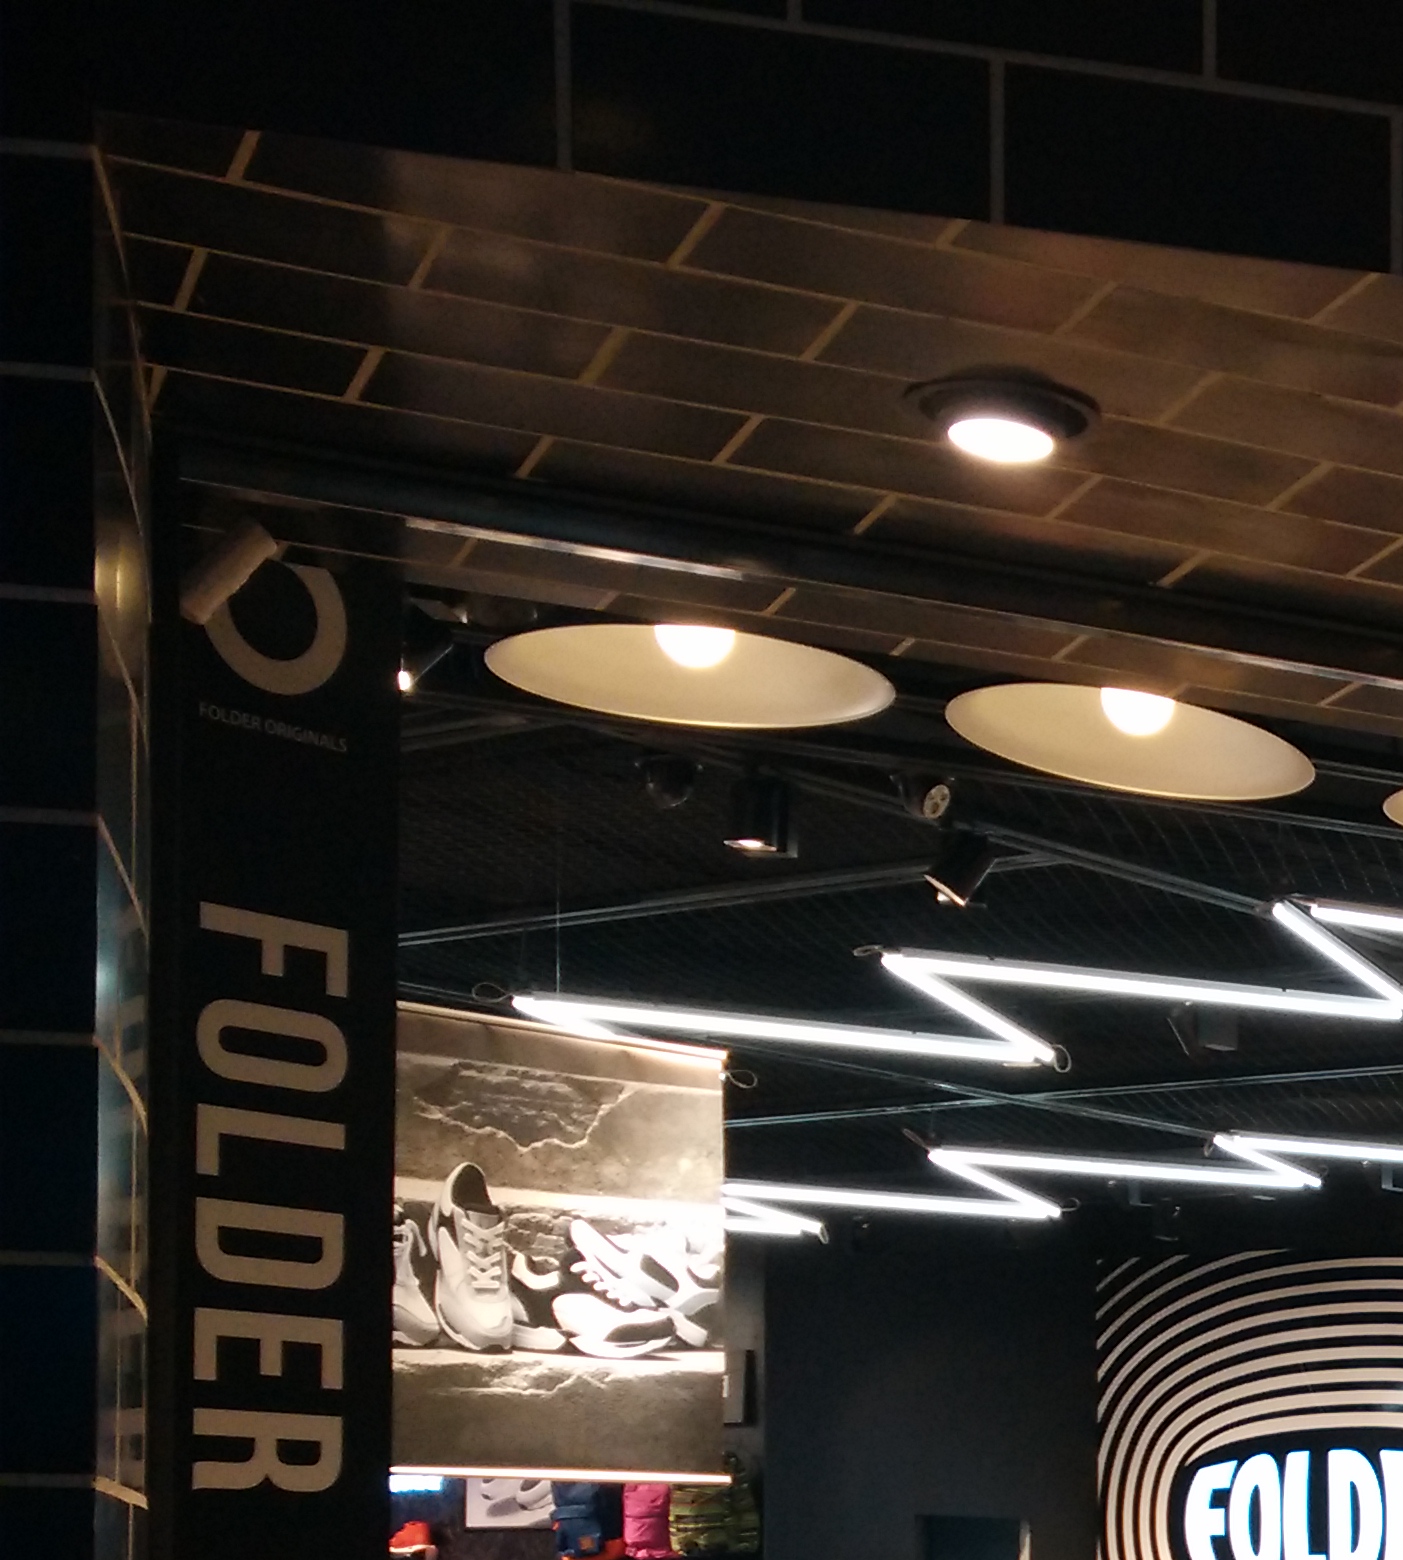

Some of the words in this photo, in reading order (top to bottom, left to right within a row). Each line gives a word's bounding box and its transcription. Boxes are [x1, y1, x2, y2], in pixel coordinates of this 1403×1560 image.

[199, 702, 261, 731] FOLDER
[264, 719, 347, 752] ORIGINALS
[191, 902, 350, 1495] FOLDER
